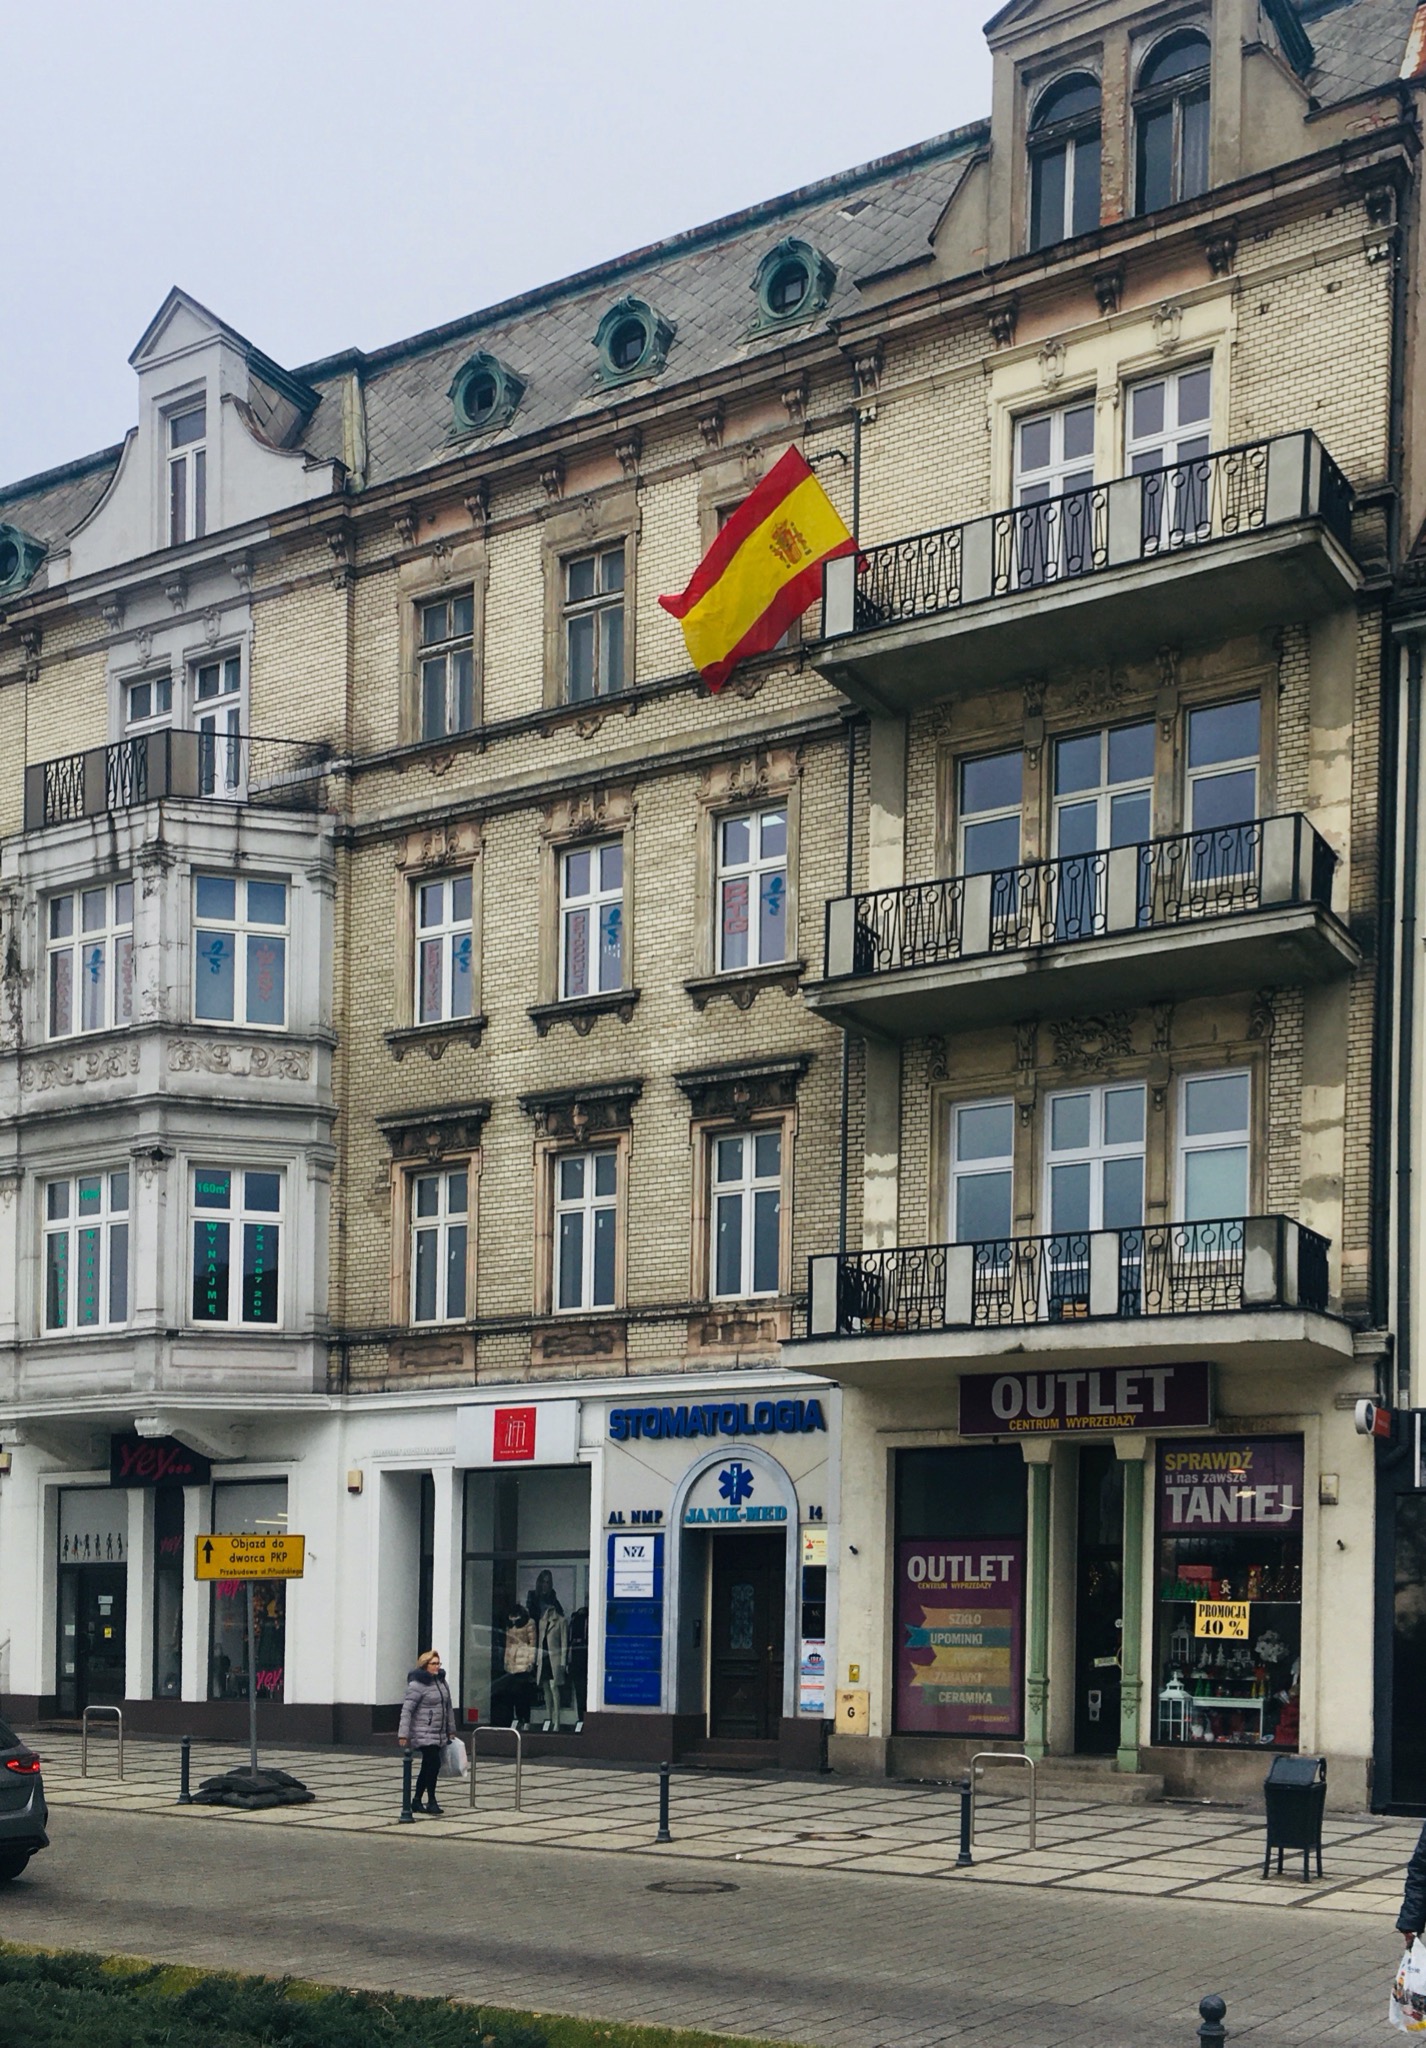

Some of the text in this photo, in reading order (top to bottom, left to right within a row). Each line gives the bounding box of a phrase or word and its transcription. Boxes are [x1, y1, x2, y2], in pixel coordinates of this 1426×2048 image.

[724, 883, 748, 935] RTG
[206, 1223, 218, 1315] WYNAJMĘ
[991, 1367, 1175, 1420] OUTLET
[609, 1399, 826, 1440] STOMATOLOGIA
[1009, 1413, 1136, 1431] CENTRUM WYPRZEDAŻY
[1165, 1472, 1247, 1484] u nas zawsze
[1166, 1485, 1293, 1523] TANIEJ
[608, 1510, 663, 1524] AL NMP
[685, 1505, 788, 1523] JANIK-MED
[809, 1505, 823, 1520] 14
[231, 1538, 284, 1551] Objazd do
[623, 1546, 645, 1558] NFZ
[229, 1552, 288, 1563] dworca PKP
[907, 1555, 1015, 1583] OUTLET
[918, 1582, 948, 1590] CENTRUM
[948, 1613, 982, 1625] SZKŁO
[1198, 1604, 1247, 1619] PROMOCJA
[1200, 1619, 1244, 1636] 40 %
[930, 1633, 983, 1645] UPOMINKI
[938, 1691, 993, 1704] CERAMIKA
[847, 1706, 855, 1718] G
